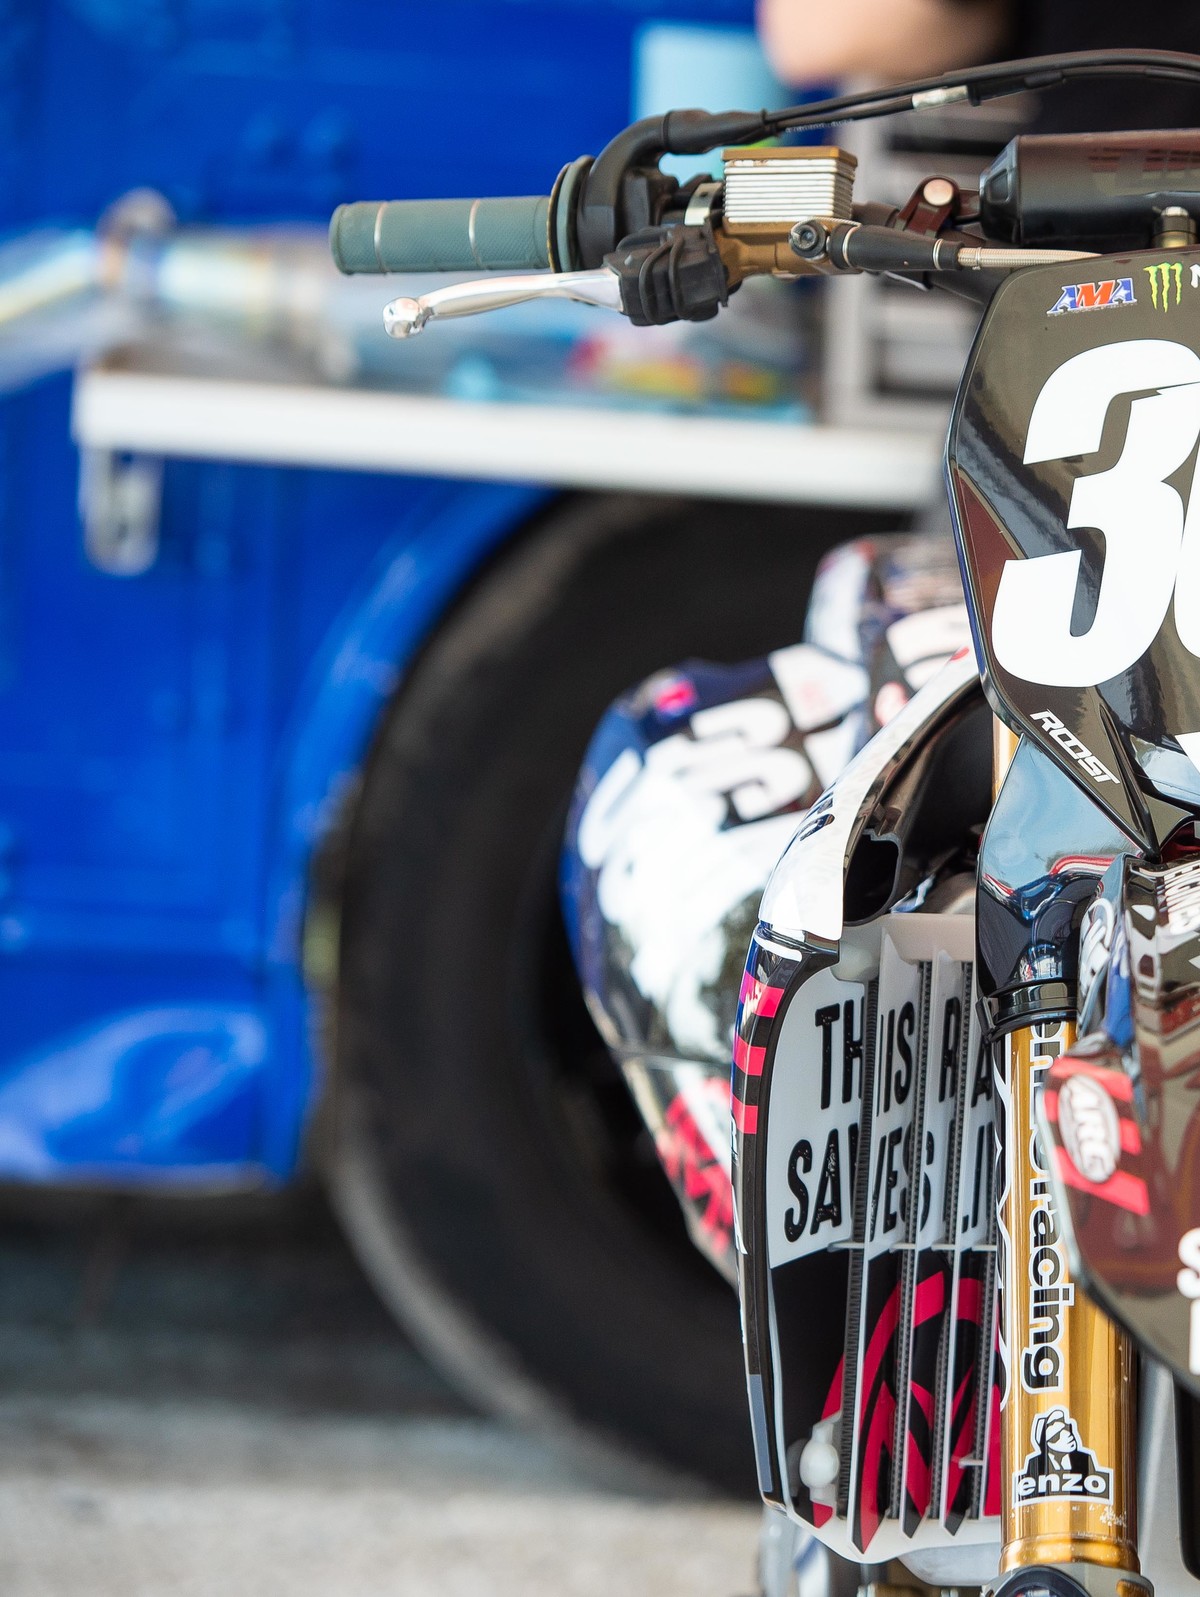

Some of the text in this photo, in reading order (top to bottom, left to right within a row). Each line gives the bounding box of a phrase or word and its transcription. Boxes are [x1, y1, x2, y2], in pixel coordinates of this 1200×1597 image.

[1046, 277, 1138, 315] AMA
[1029, 708, 1121, 784] ROOST
[1017, 1473, 1107, 1497] enzo
